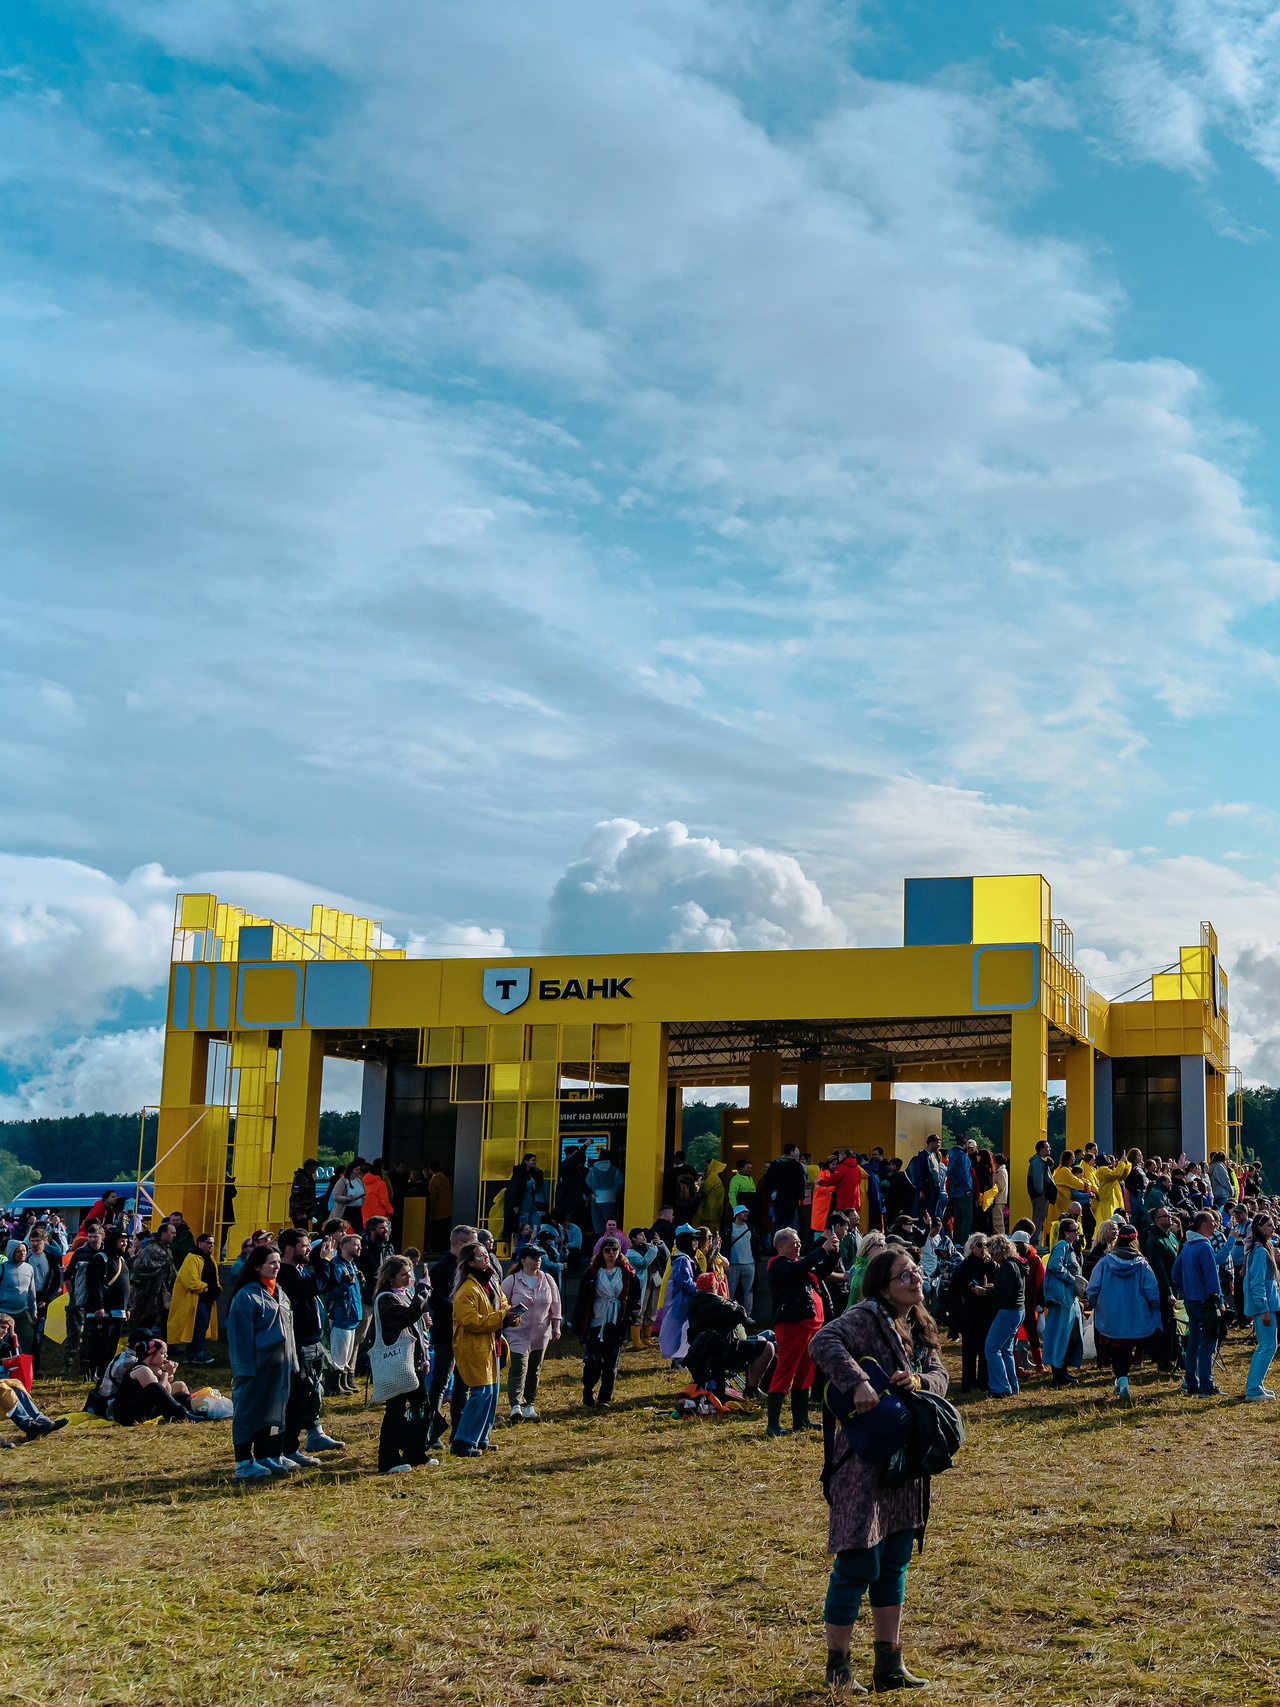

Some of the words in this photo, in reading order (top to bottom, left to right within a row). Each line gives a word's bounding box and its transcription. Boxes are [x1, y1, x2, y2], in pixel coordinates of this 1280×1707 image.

[496, 980, 517, 1000] Т
[539, 977, 634, 1000] БАНК
[383, 1348, 401, 1359] BALI
